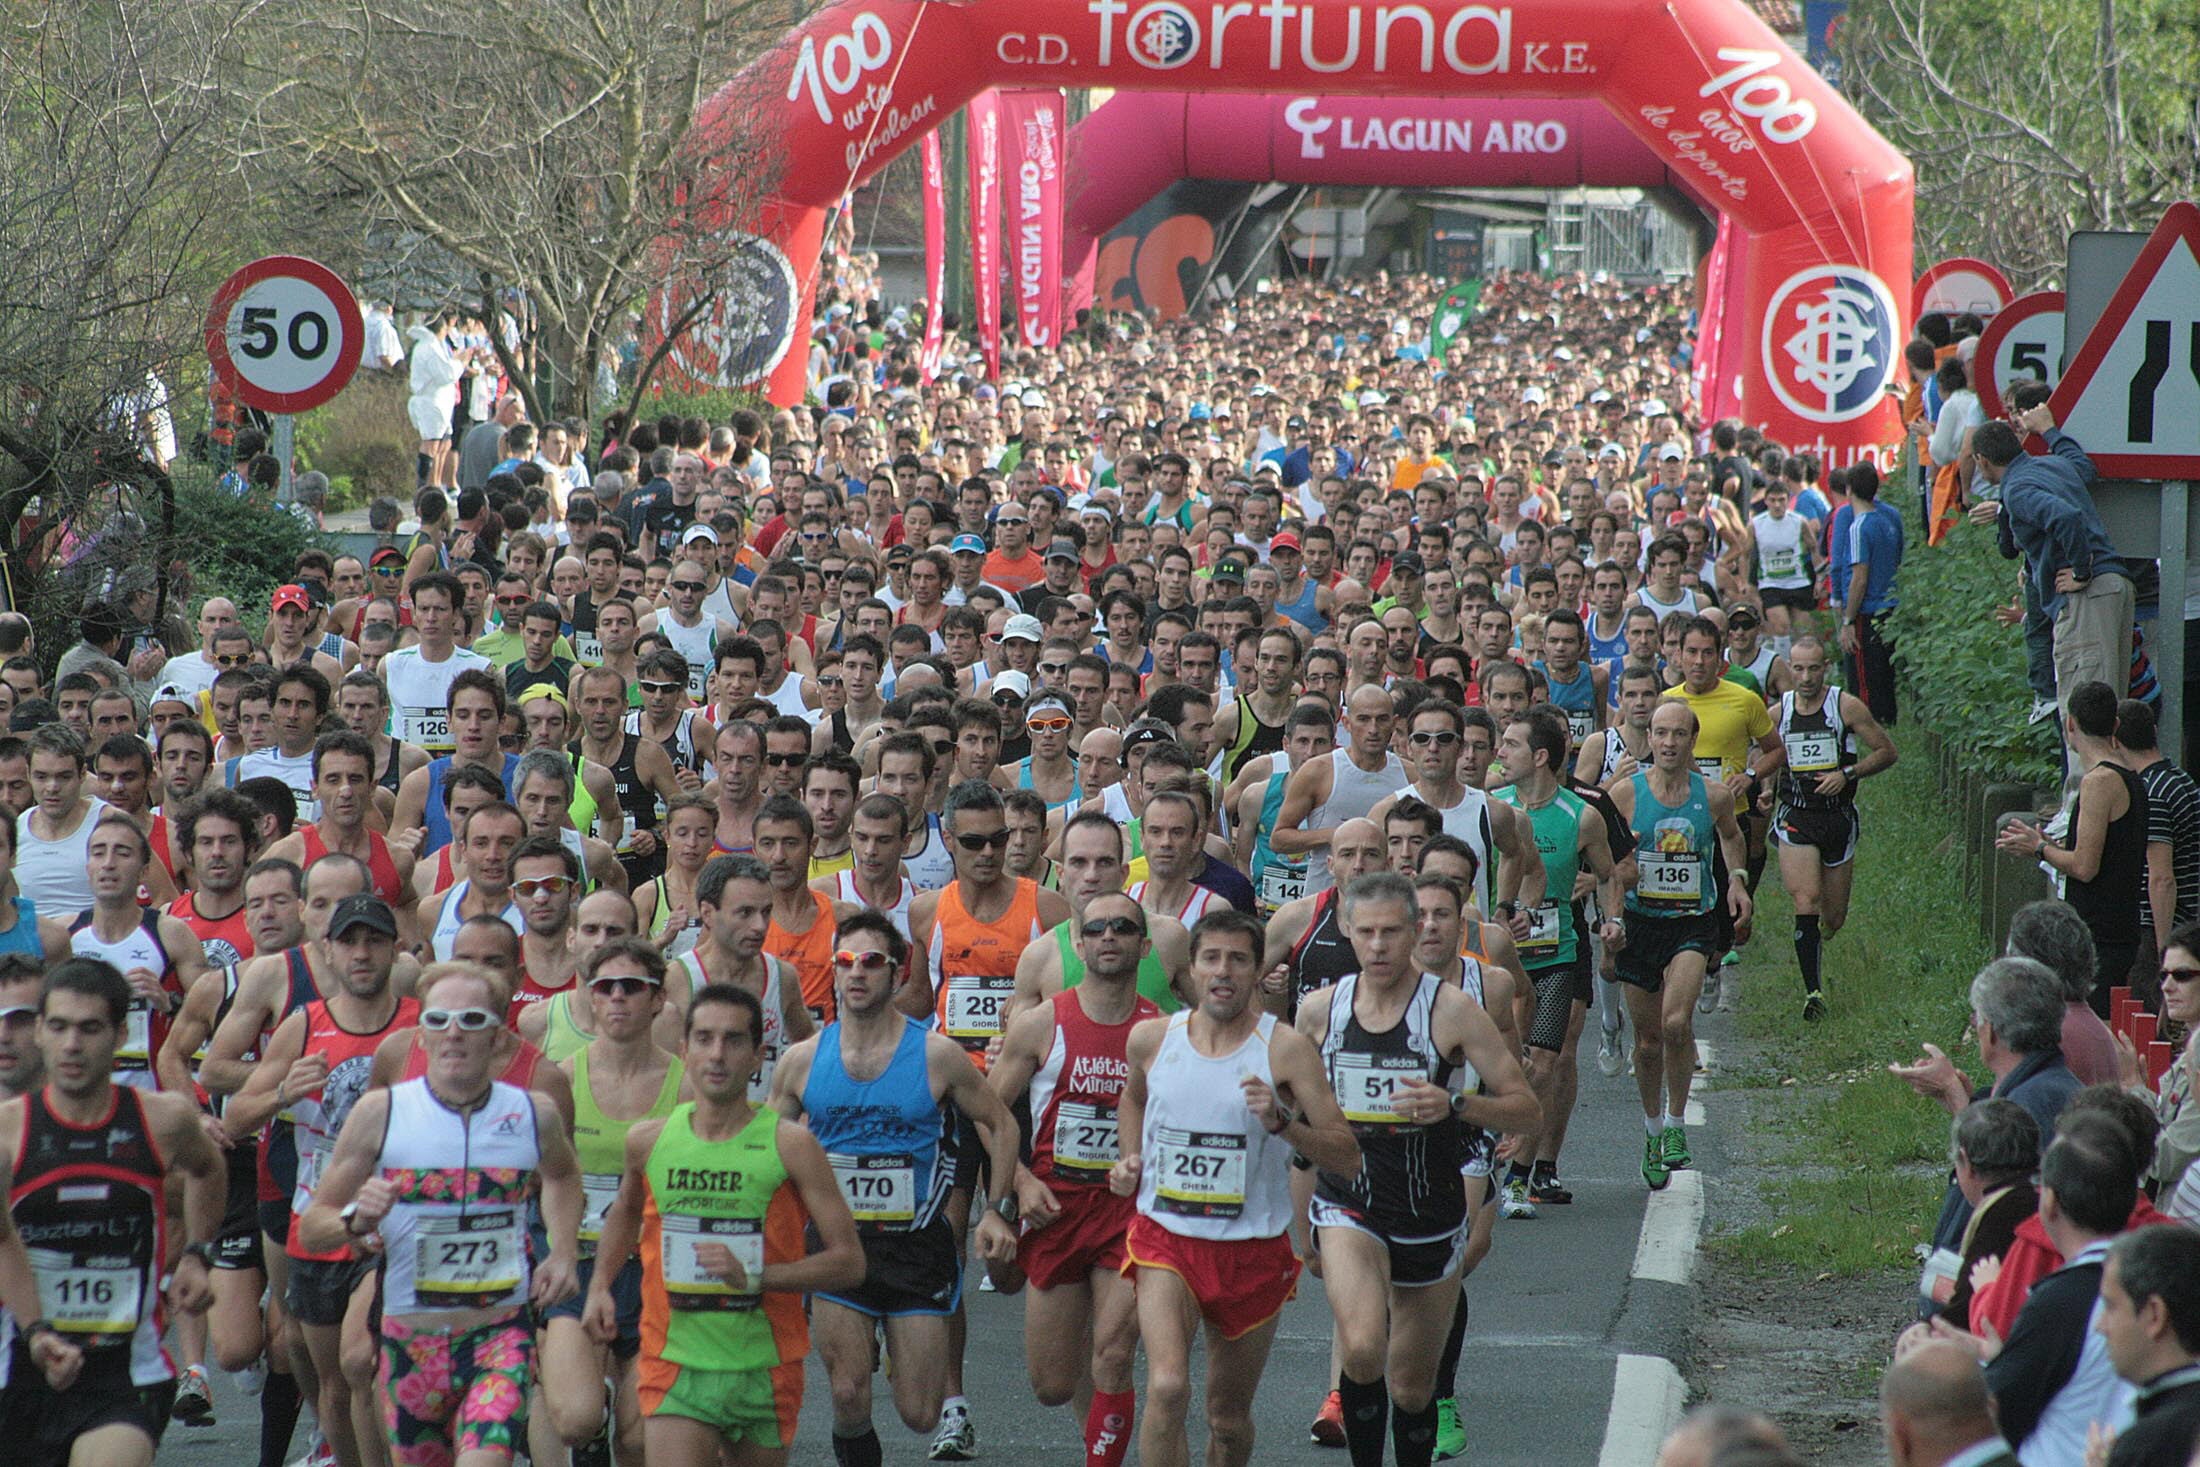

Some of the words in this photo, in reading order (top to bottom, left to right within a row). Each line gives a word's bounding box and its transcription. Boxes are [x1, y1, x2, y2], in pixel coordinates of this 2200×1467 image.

[996, 31, 1077, 66] C.D.
[1522, 42, 1597, 75] K.E.
[787, 12, 892, 124] 100
[1700, 48, 1817, 144] 100
[1340, 116, 1480, 151] LAGUN
[1482, 119, 1567, 154] ARO
[240, 307, 329, 360] 50
[2009, 342, 2064, 383] 5
[416, 721, 448, 736] 126
[1801, 744, 1822, 758] 52
[1654, 867, 1690, 883] 136
[989, 979, 1016, 988] adida
[972, 1020, 999, 1028] GIORG
[1072, 1056, 1128, 1077] Atlétic
[1382, 1057, 1419, 1069] adidas
[1365, 1077, 1395, 1099] 51
[1367, 1104, 1392, 1112] JESU
[1201, 1136, 1239, 1148] adidas
[868, 1158, 905, 1169] adidas
[1174, 1153, 1227, 1179] 267
[846, 1176, 894, 1198] 170
[1181, 1182, 1216, 1192] CHEMA
[854, 1202, 887, 1210] SERGIO
[711, 1220, 754, 1234] adidas
[440, 1239, 499, 1265] 273
[55, 1279, 113, 1305] 116
